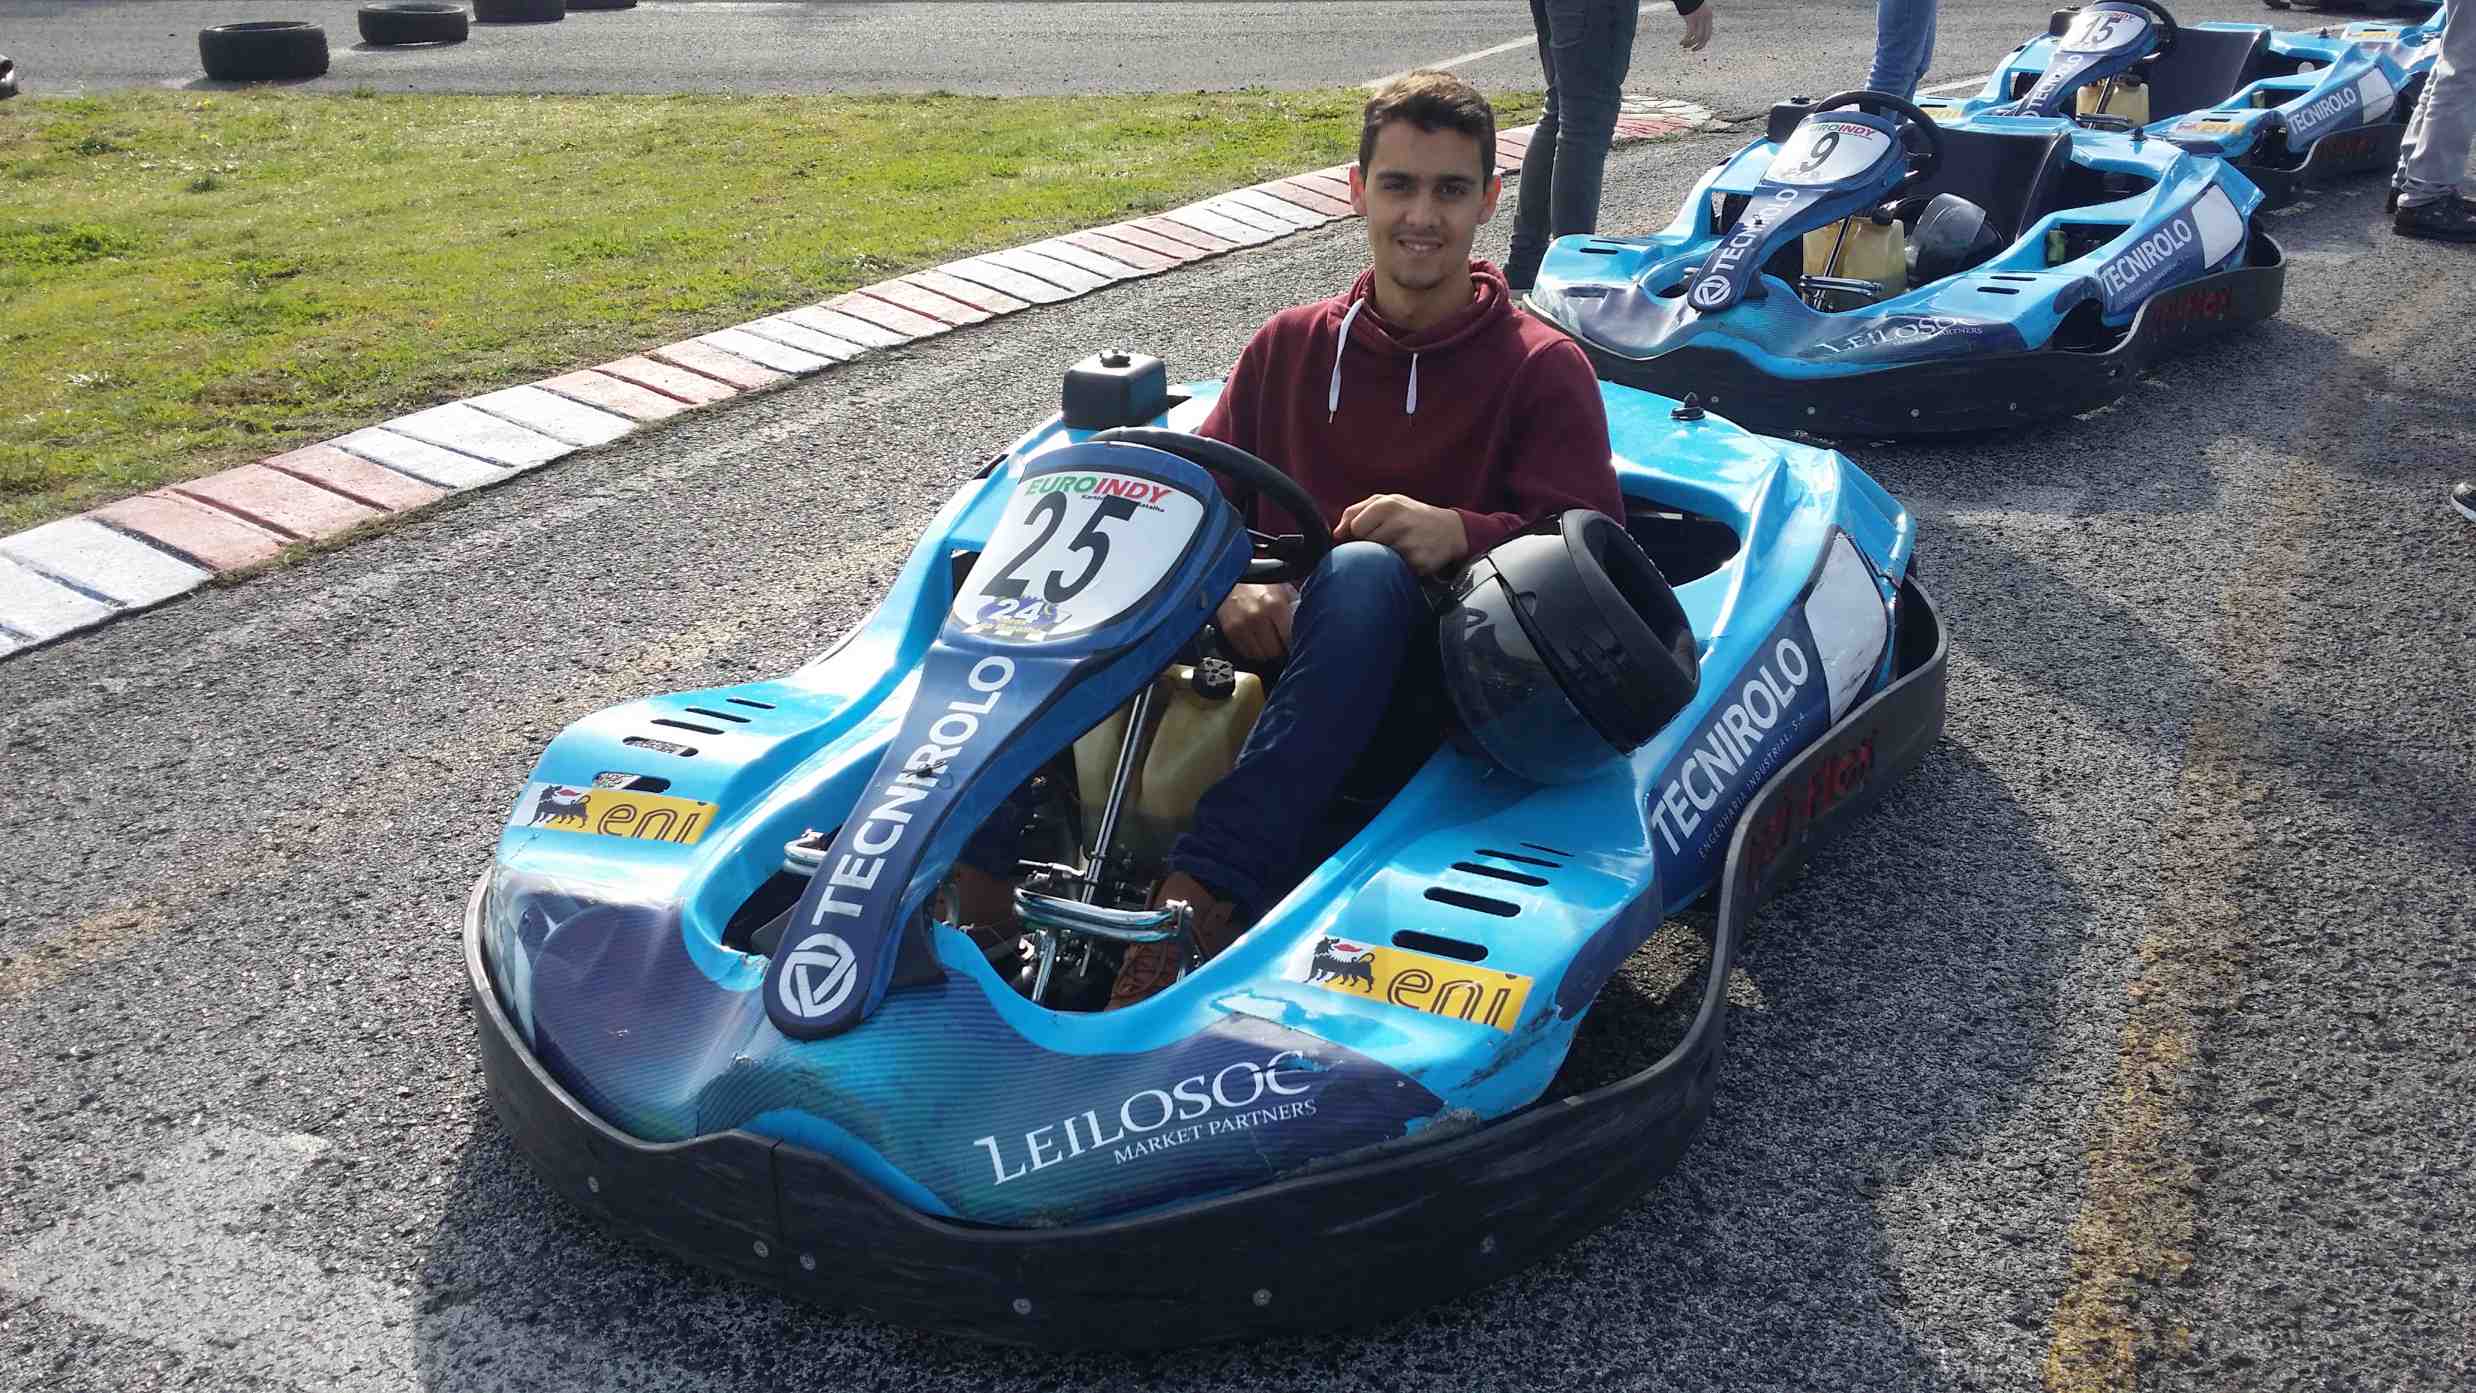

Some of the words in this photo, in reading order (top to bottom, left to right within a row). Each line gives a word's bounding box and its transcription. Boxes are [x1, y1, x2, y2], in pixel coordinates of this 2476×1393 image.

[2288, 88, 2357, 135] TECNIROLO
[1800, 131, 1840, 172] 9
[2101, 219, 2192, 297] TECNIROLO
[1025, 475, 1175, 504] EUROINDY
[980, 490, 1138, 603] 25
[988, 598, 1044, 624] 24
[1652, 638, 1809, 855] TECNIROLO
[596, 800, 709, 844] eni
[812, 655, 1015, 926] TECNIROLO
[1387, 966, 1518, 1031] eni
[974, 1050, 1311, 1186] LEILOSOC
[1113, 1125, 1201, 1166] MARKET
[1208, 1098, 1317, 1135] PARTNERS
